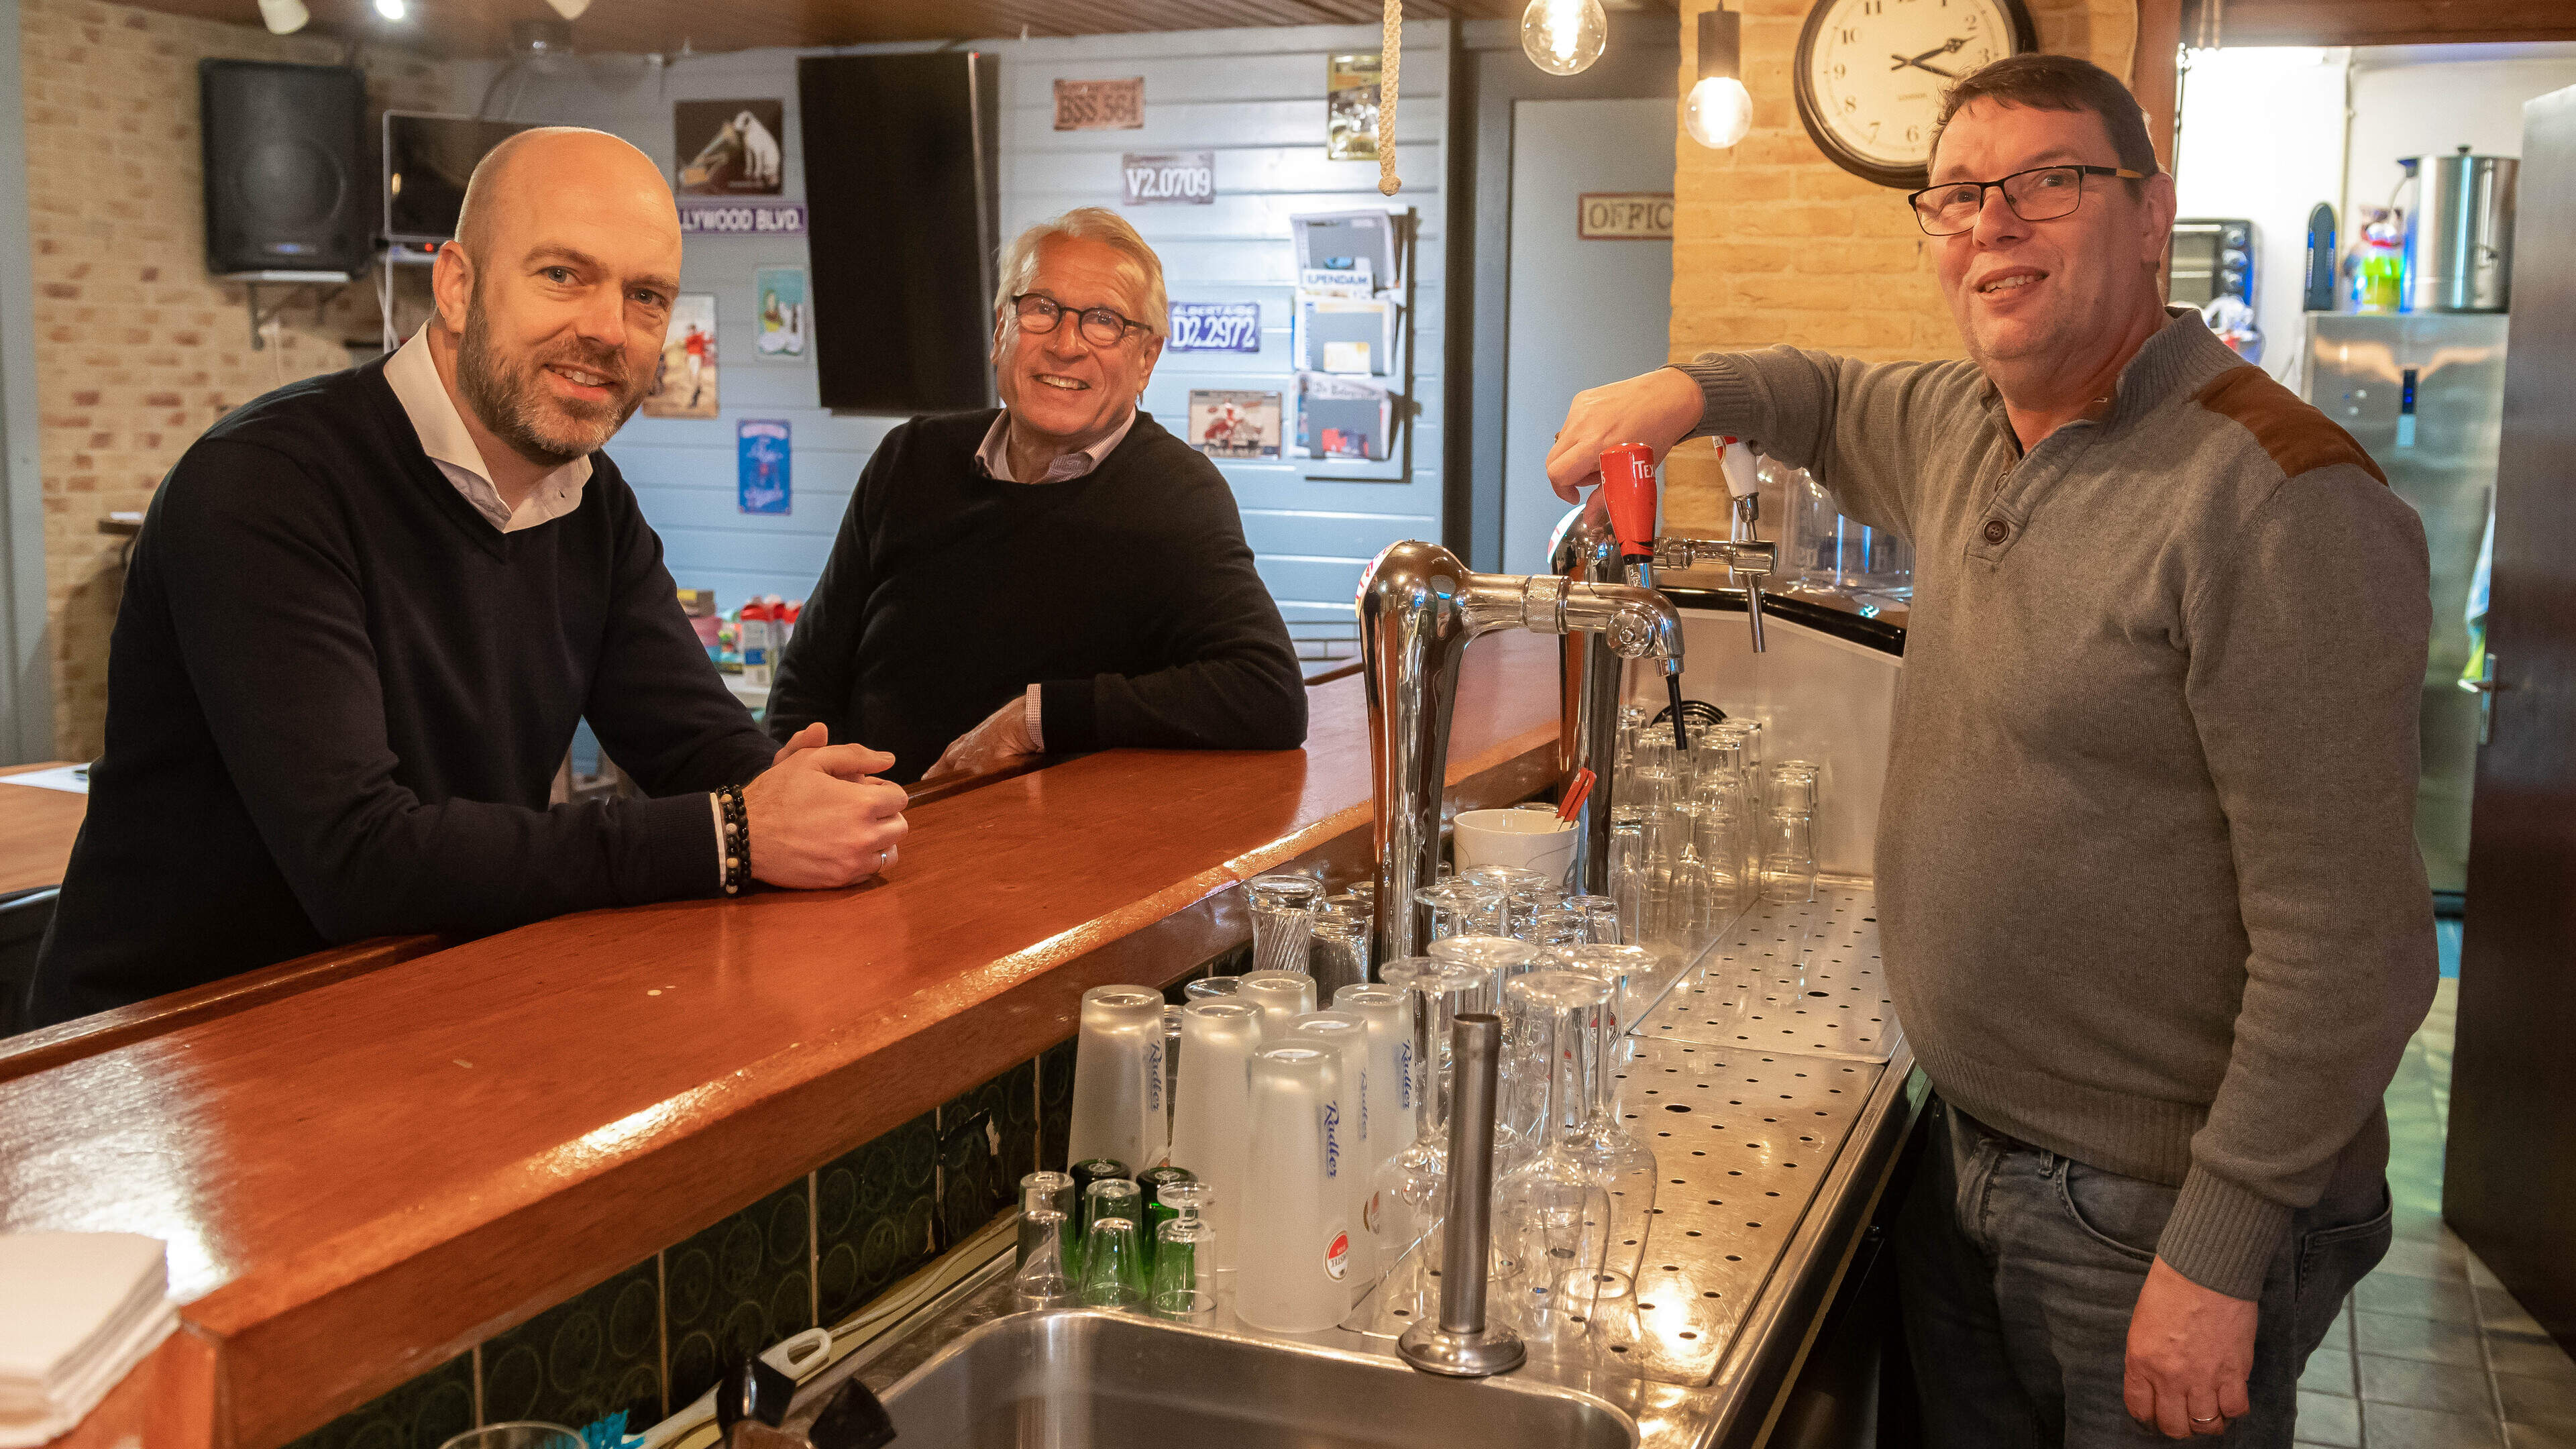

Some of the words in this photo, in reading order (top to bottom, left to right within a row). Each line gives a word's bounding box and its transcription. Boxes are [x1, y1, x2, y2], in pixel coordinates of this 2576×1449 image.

[1964, 14, 1977, 31] 2
[1842, 28, 1862, 44] 10
[1834, 64, 1846, 80] 9
[1844, 96, 1857, 113] 8
[1869, 121, 1881, 144] 7
[1905, 124, 1919, 143] 6
[1589, 202, 1673, 229] OFFIC
[1148, 1040, 1163, 1112] Radler
[1401, 1038, 1412, 1110] Radler
[1324, 1099, 1340, 1179] Radler
